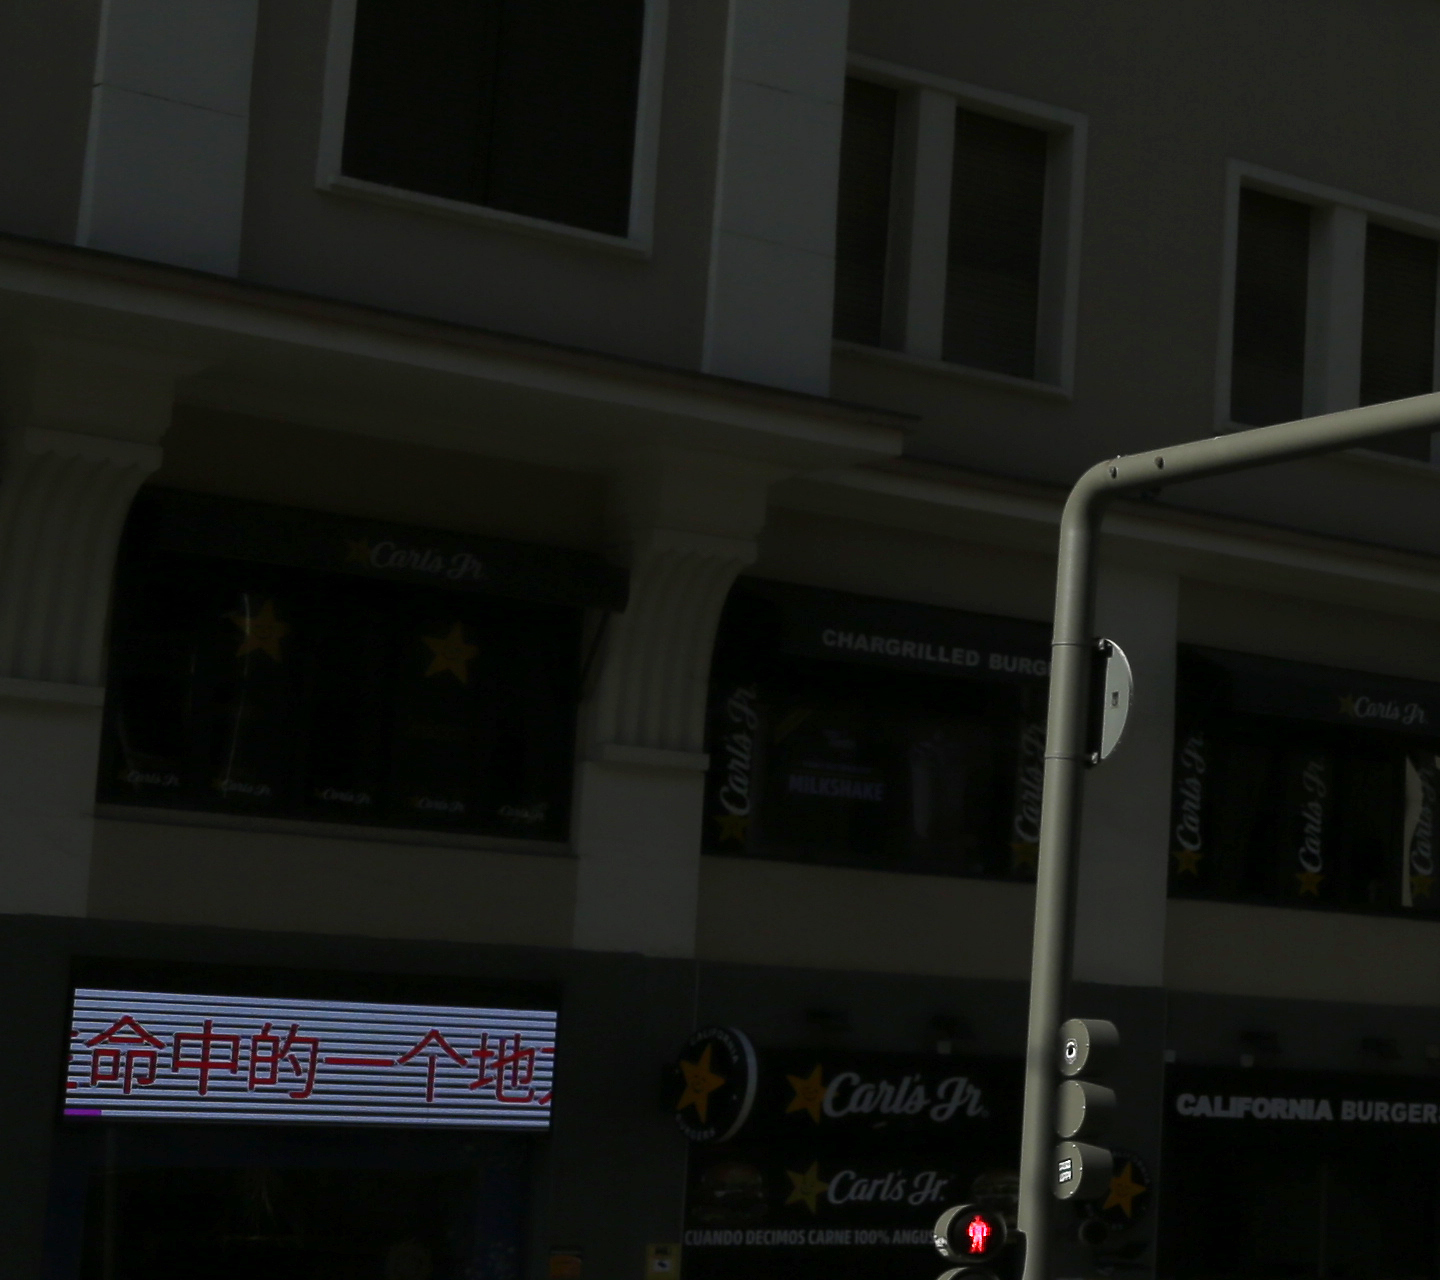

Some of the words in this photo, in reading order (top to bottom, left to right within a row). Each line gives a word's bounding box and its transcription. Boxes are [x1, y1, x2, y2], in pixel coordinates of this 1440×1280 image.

[821, 628, 981, 668] CHARGRILLED
[65, 1015, 556, 1104] 命中的一个地
[821, 1071, 931, 1119] Carl's
[1175, 1092, 1334, 1122] CALIFORNIA
[826, 1170, 904, 1206] Carl's
[684, 1229, 743, 1246] CUANDO
[744, 1229, 806, 1246] DECIMOS
[807, 1229, 851, 1246] CARNE
[852, 1229, 890, 1246] 100%
